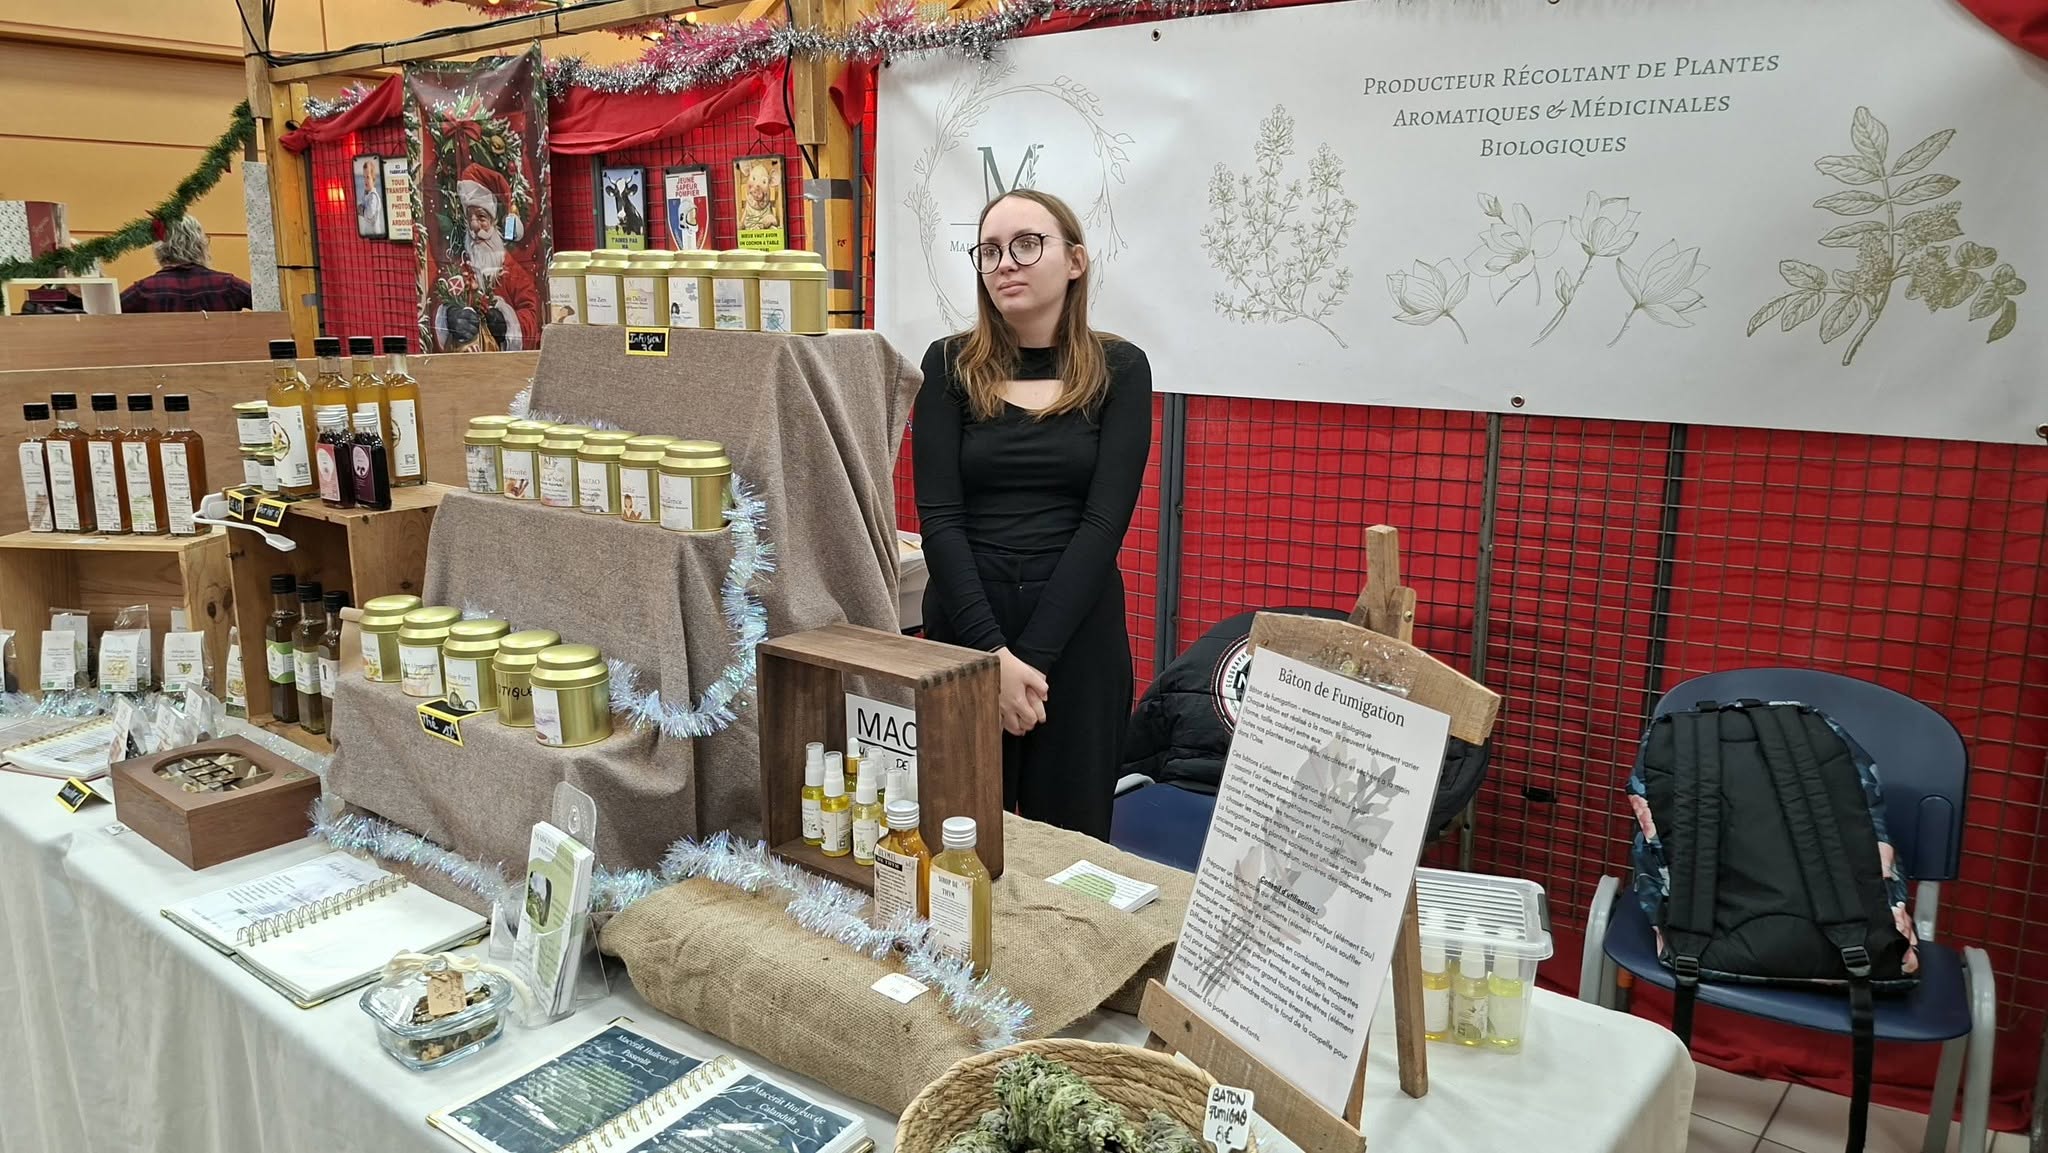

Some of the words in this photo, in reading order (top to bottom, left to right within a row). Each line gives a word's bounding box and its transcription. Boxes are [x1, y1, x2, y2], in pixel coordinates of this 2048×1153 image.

[1363, 72, 1496, 95] PRODUCTEUR
[1502, 64, 1630, 87] RÉCOLTANT
[1637, 62, 1666, 80] DE
[1674, 55, 1780, 77] PLANTES
[1393, 104, 1540, 127] AROMATIQUES
[1546, 100, 1568, 120] &
[1570, 95, 1730, 118] MÉDICINALES
[1480, 136, 1626, 158] BIOLOGIQUES
[675, 190, 700, 198] POMPIER
[676, 183, 698, 191] SAPEUR
[1278, 667, 1311, 691] Bâton
[1314, 680, 1329, 698] de
[1332, 687, 1404, 727] Fumigation
[896, 759, 908, 770] DE
[759, 1103, 797, 1126] Calandula
